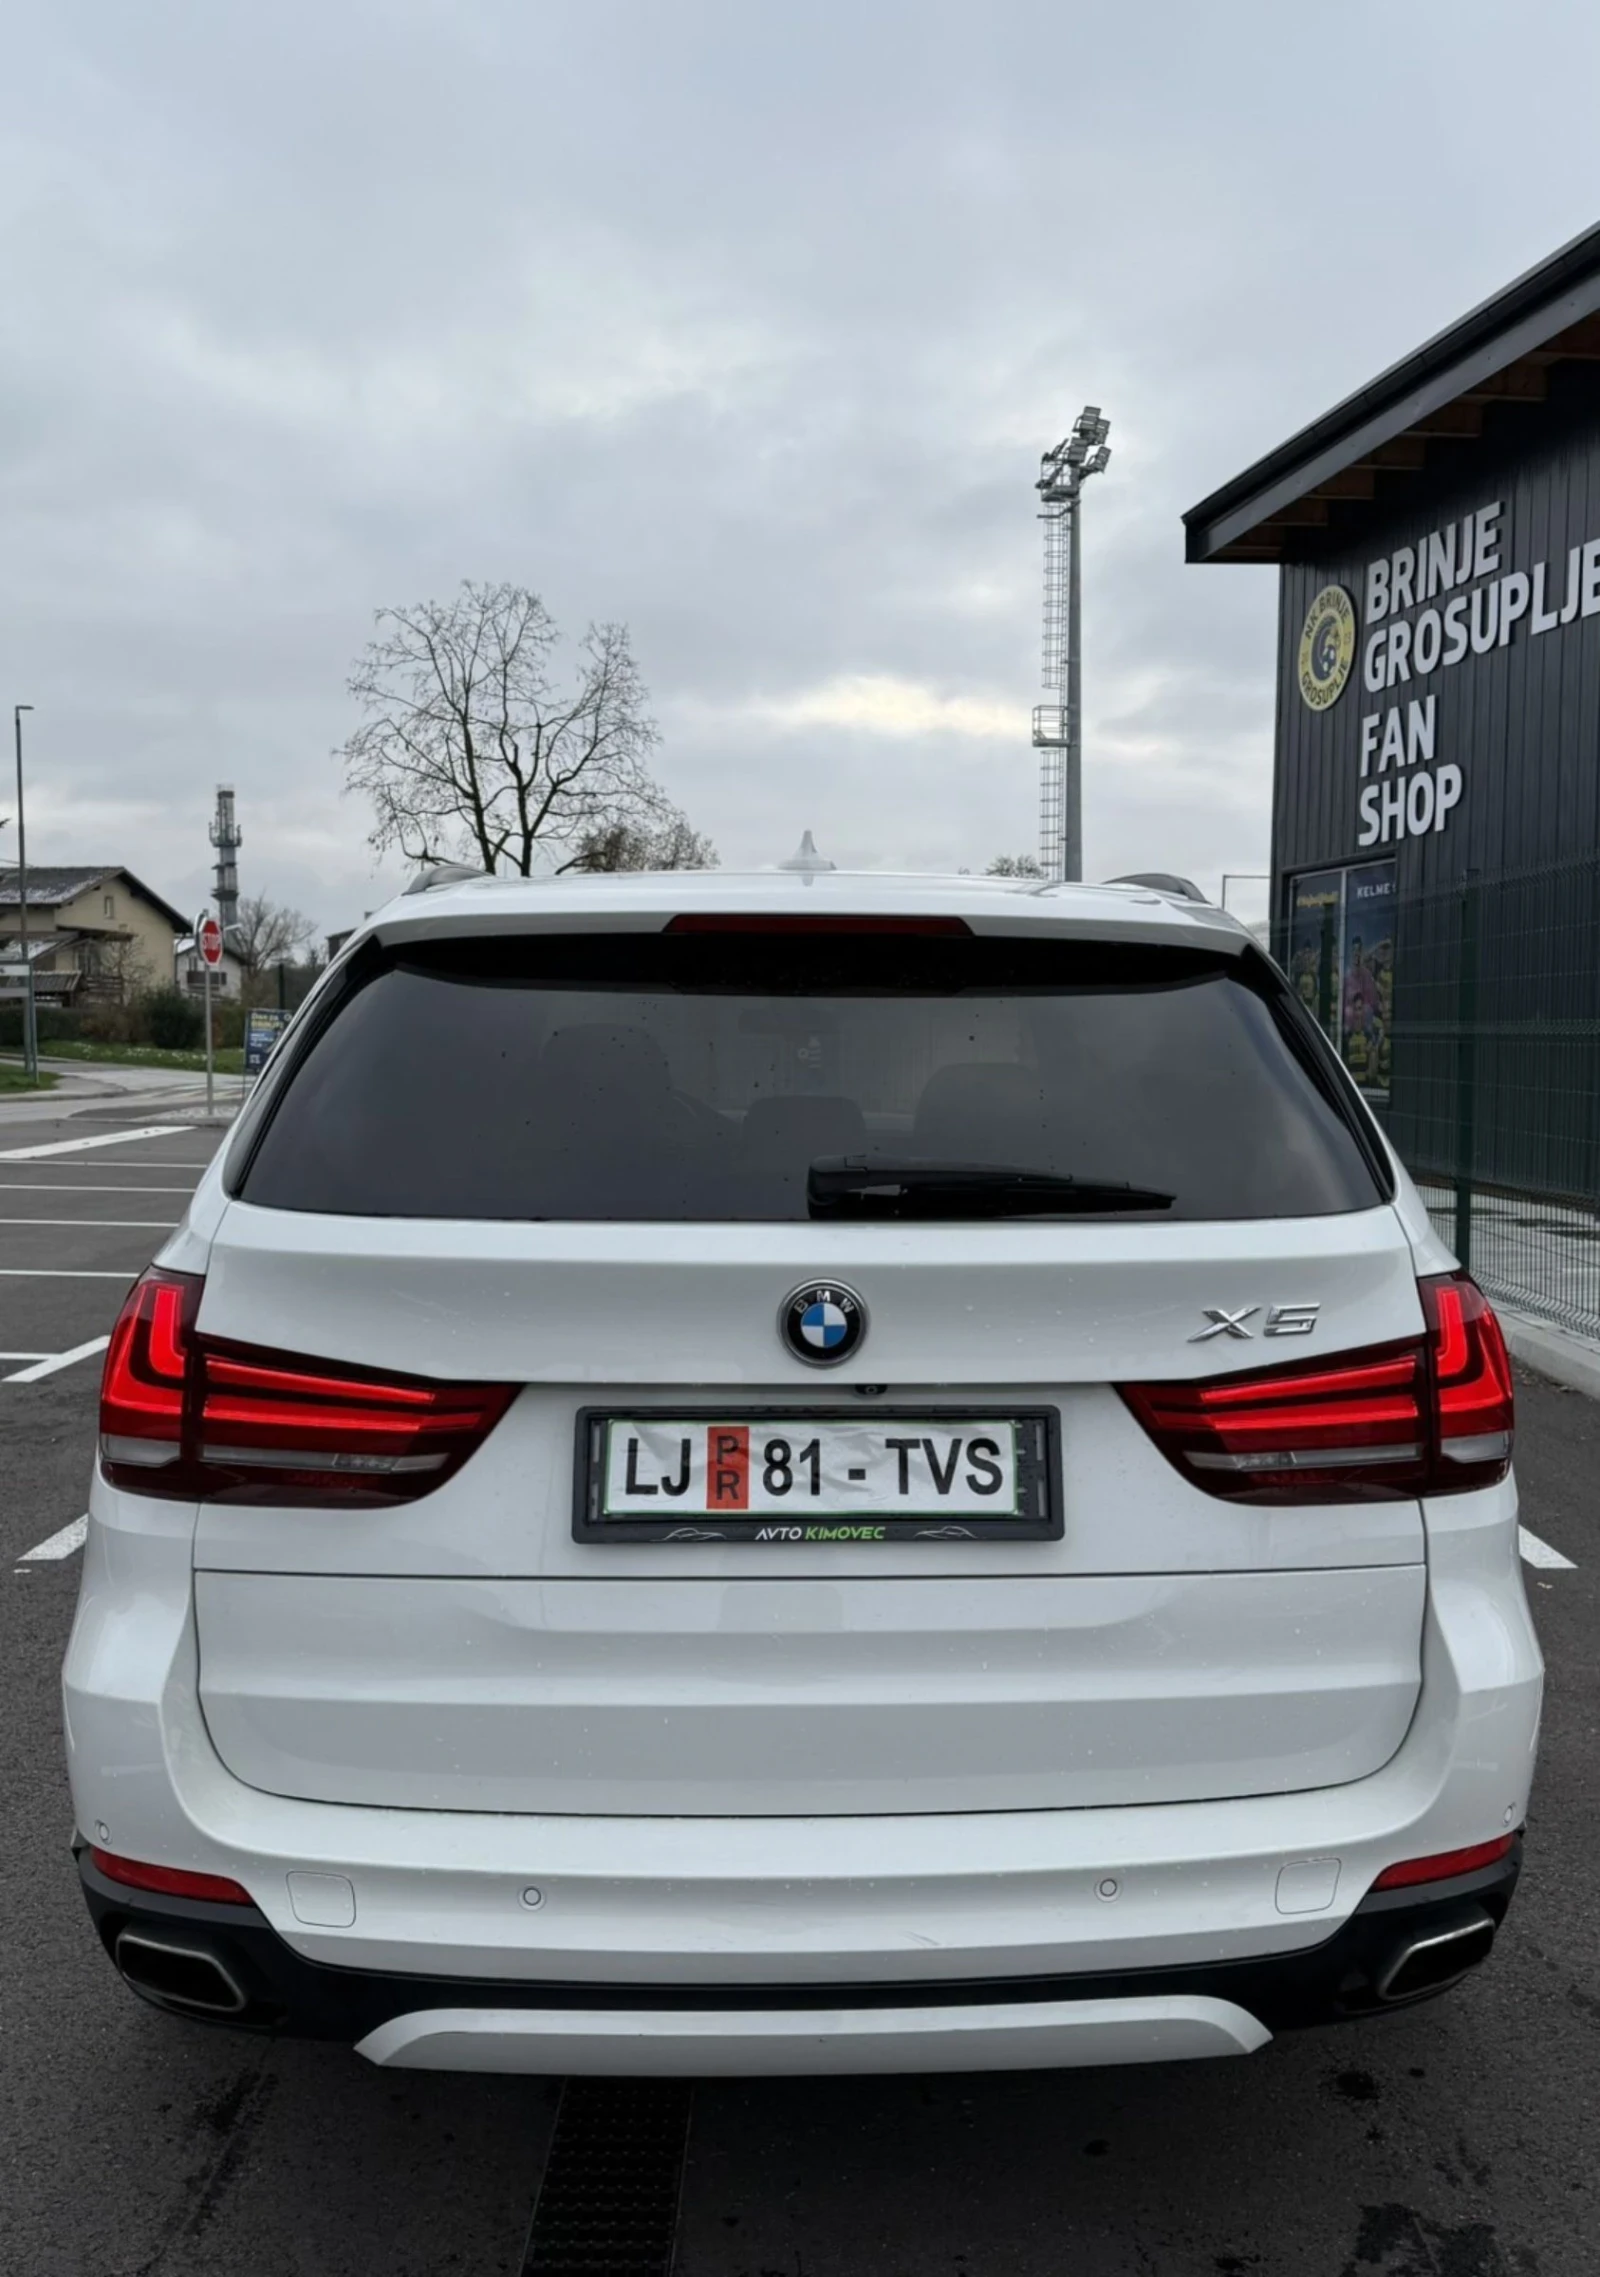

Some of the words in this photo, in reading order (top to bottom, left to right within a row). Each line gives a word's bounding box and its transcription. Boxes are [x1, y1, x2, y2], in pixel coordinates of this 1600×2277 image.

[1366, 500, 1501, 625] BRINJE
[1305, 608, 1318, 640] NK
[1319, 591, 1350, 623] BRINJE
[1364, 538, 1600, 693] GROSUPLJE
[1360, 694, 1436, 778] FAN
[1358, 763, 1463, 847] SHOP
[1357, 883, 1390, 898] KELME
[202, 932, 221, 950] STOP
[794, 1290, 854, 1314] BMW
[1187, 1302, 1321, 1343] X5
[625, 1438, 691, 1496] LJ
[885, 1438, 1003, 1496] TVS
[755, 1527, 802, 1540] AVTO
[805, 1526, 886, 1540] KIMOVEC
